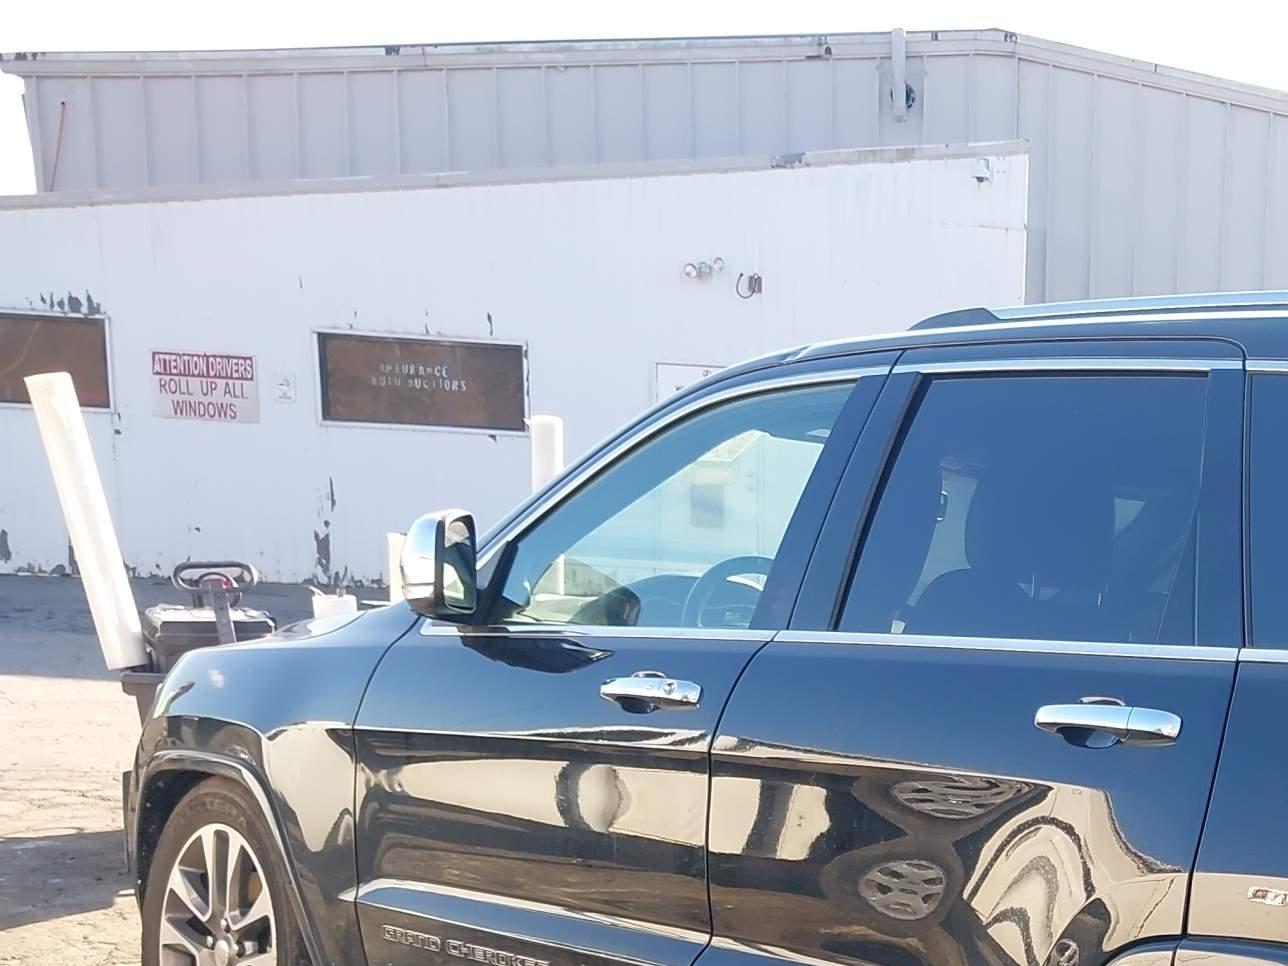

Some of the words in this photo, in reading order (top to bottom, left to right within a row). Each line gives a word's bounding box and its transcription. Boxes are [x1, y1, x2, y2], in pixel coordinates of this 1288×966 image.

[153, 353, 208, 377] ATTENTION
[209, 356, 252, 379] DRIVERS
[159, 378, 194, 396] ROLL
[200, 381, 218, 397] UP
[223, 382, 249, 399] ALL
[172, 399, 238, 420] WINDOWS
[381, 924, 441, 952] GRAND
